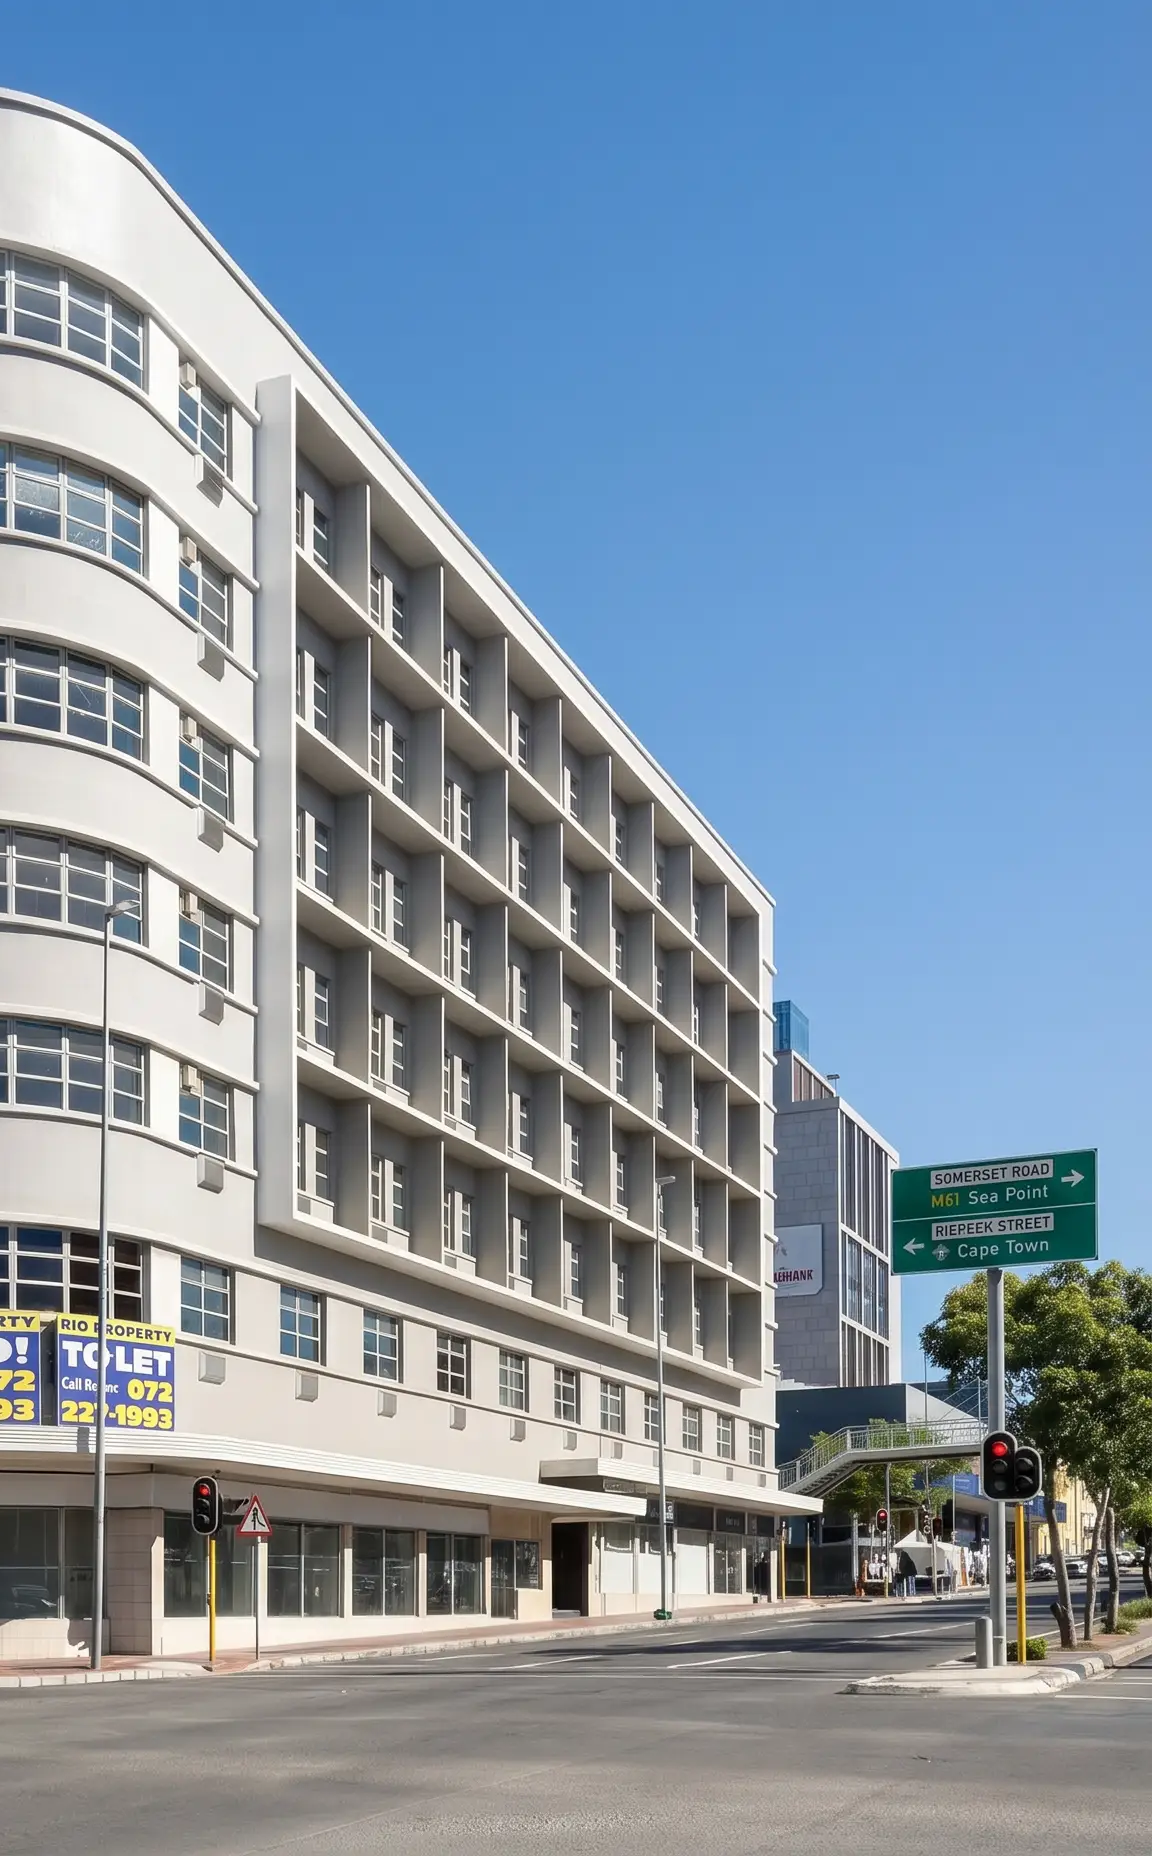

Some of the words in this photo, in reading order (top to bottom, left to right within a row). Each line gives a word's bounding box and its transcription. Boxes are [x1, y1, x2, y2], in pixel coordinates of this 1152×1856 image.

[934, 1166, 1008, 1186] SOMERSET
[1012, 1163, 1050, 1177] ROAD
[931, 1192, 960, 1209] M61
[968, 1190, 998, 1205] Sea
[1005, 1184, 1049, 1202] Point
[997, 1215, 1051, 1232] STREET
[957, 1243, 999, 1260] Cape
[1005, 1239, 1049, 1255] Town
[61, 1318, 88, 1332] RIO
[115, 1345, 172, 1377] LET
[61, 1376, 82, 1391] Call
[127, 1378, 173, 1403] 072
